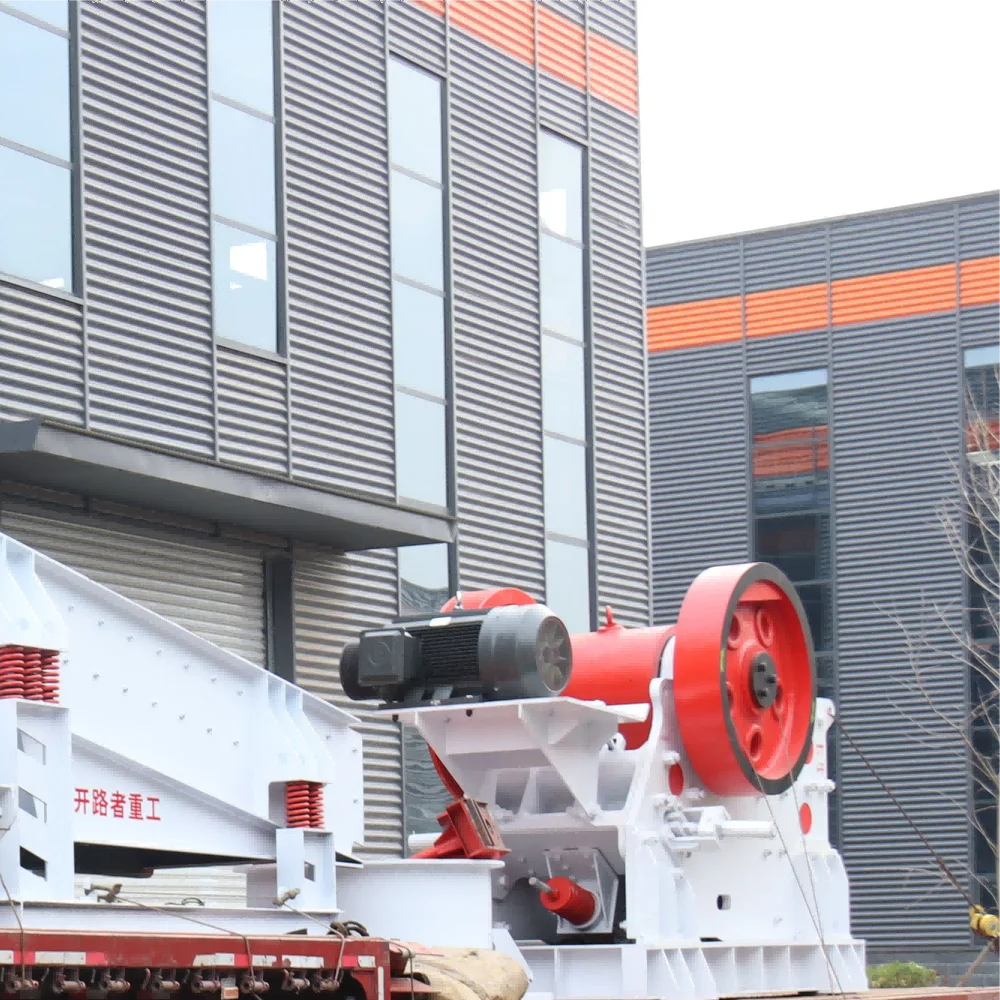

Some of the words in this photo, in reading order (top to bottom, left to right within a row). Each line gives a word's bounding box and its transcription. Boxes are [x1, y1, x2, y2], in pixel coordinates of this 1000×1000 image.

[73, 787, 162, 821] 开路者重工
